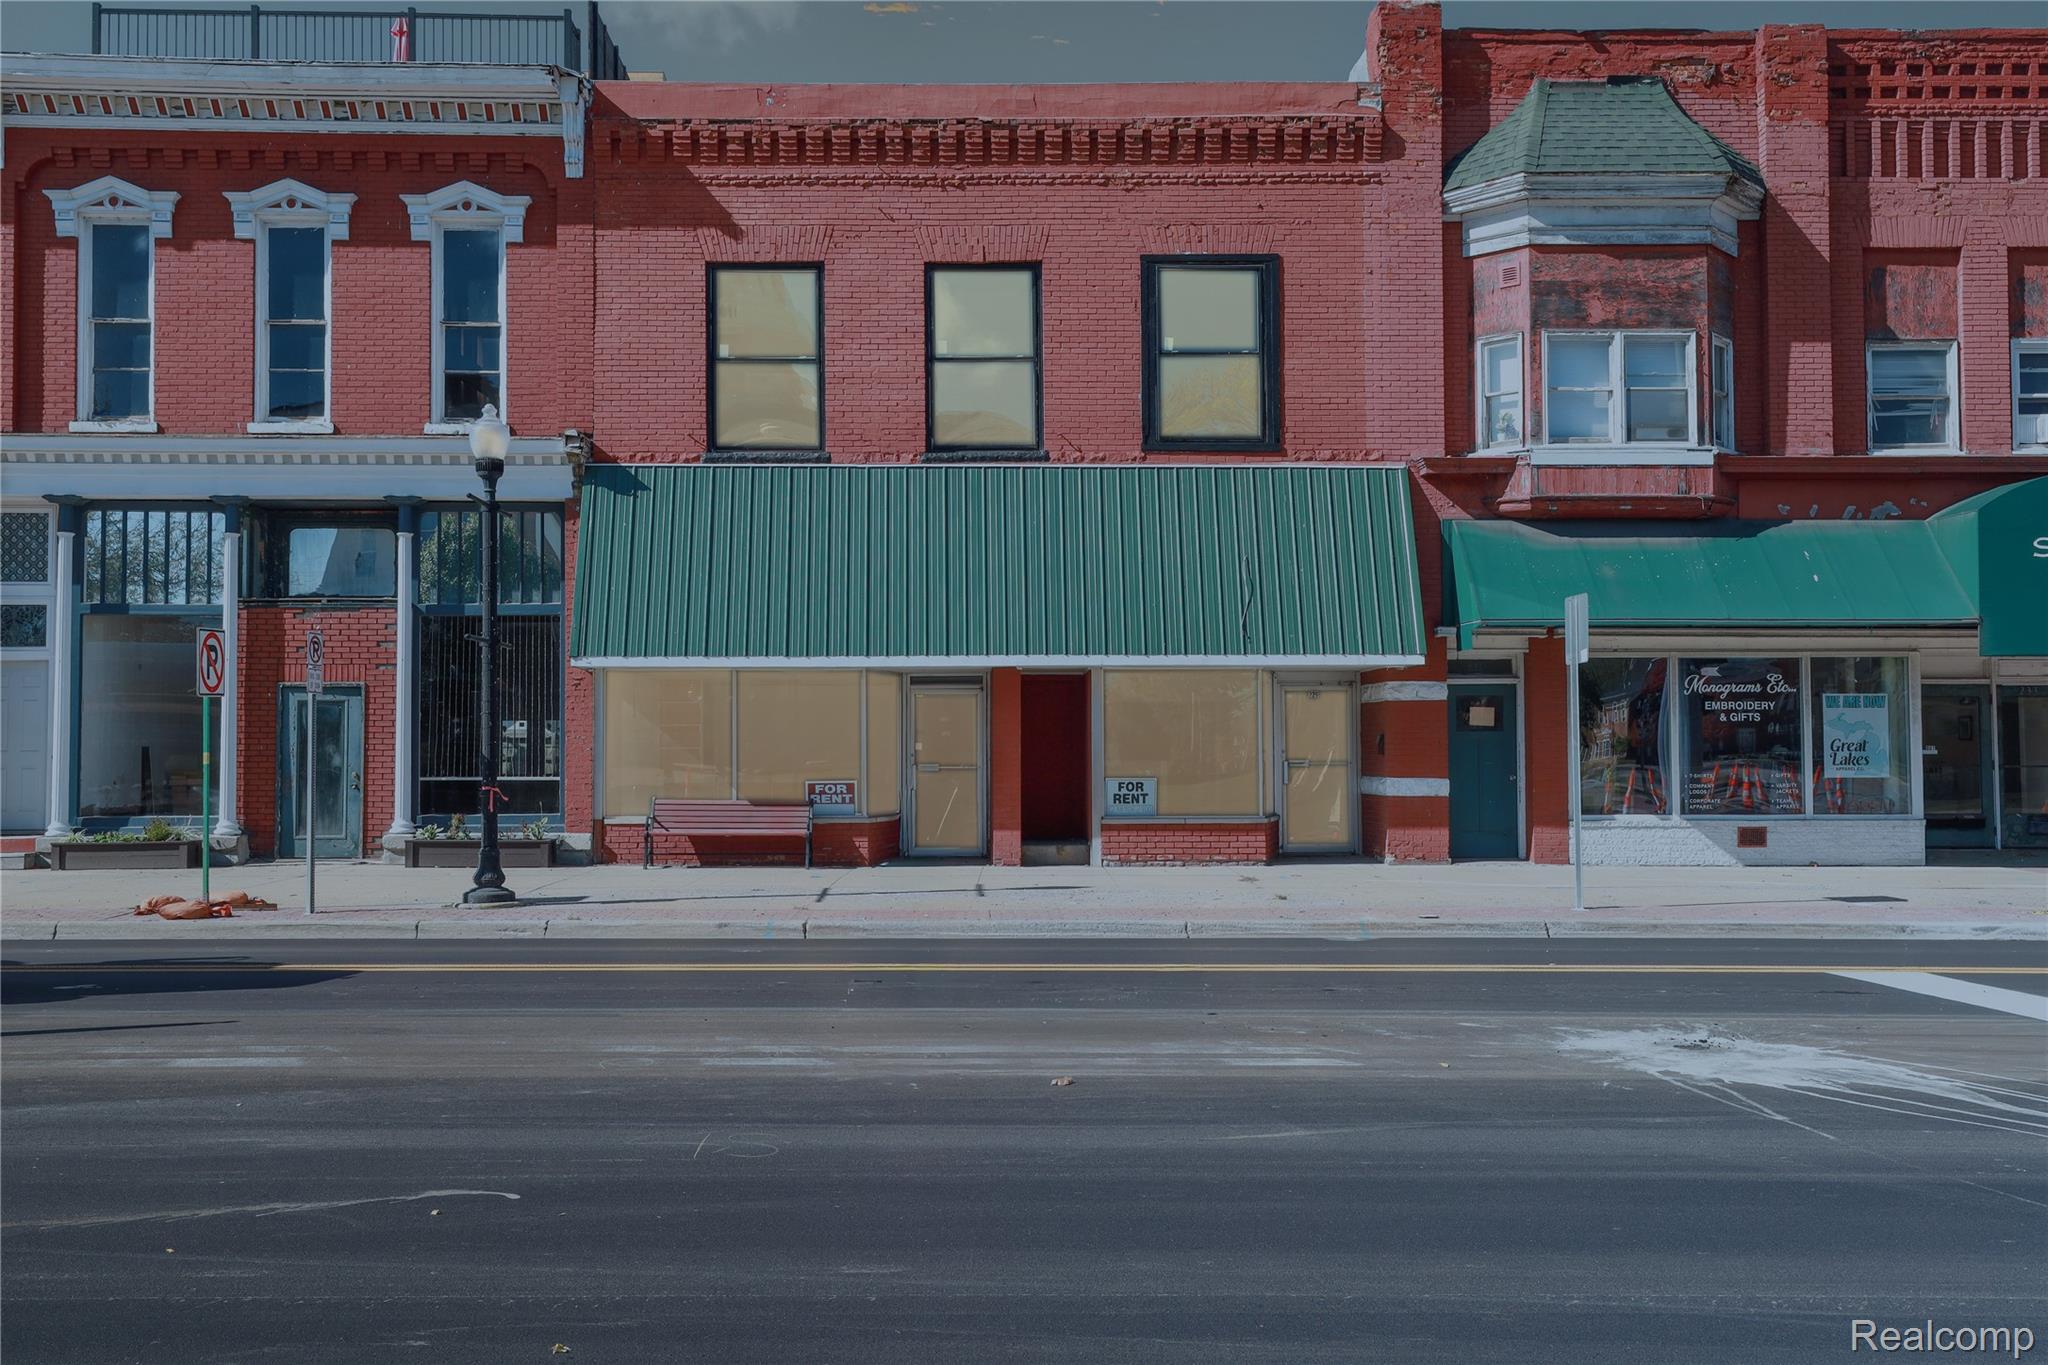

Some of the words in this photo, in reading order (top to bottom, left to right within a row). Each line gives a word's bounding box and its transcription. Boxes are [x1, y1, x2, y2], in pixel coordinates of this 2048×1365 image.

[1683, 674, 1762, 699] Monograms
[1704, 701, 1776, 711] EMBROIDERY
[1824, 695, 1841, 708] WE
[1843, 695, 1861, 708] ARE
[1863, 695, 1886, 708] NOW
[1719, 712, 1728, 722] &
[1729, 712, 1761, 722] GIFTS
[1830, 738, 1868, 753] Great
[1829, 752, 1871, 767] Lakes
[816, 784, 847, 794] FOR
[1118, 782, 1144, 792] FOR
[810, 794, 854, 804] RENT
[1113, 792, 1149, 804] RENT
